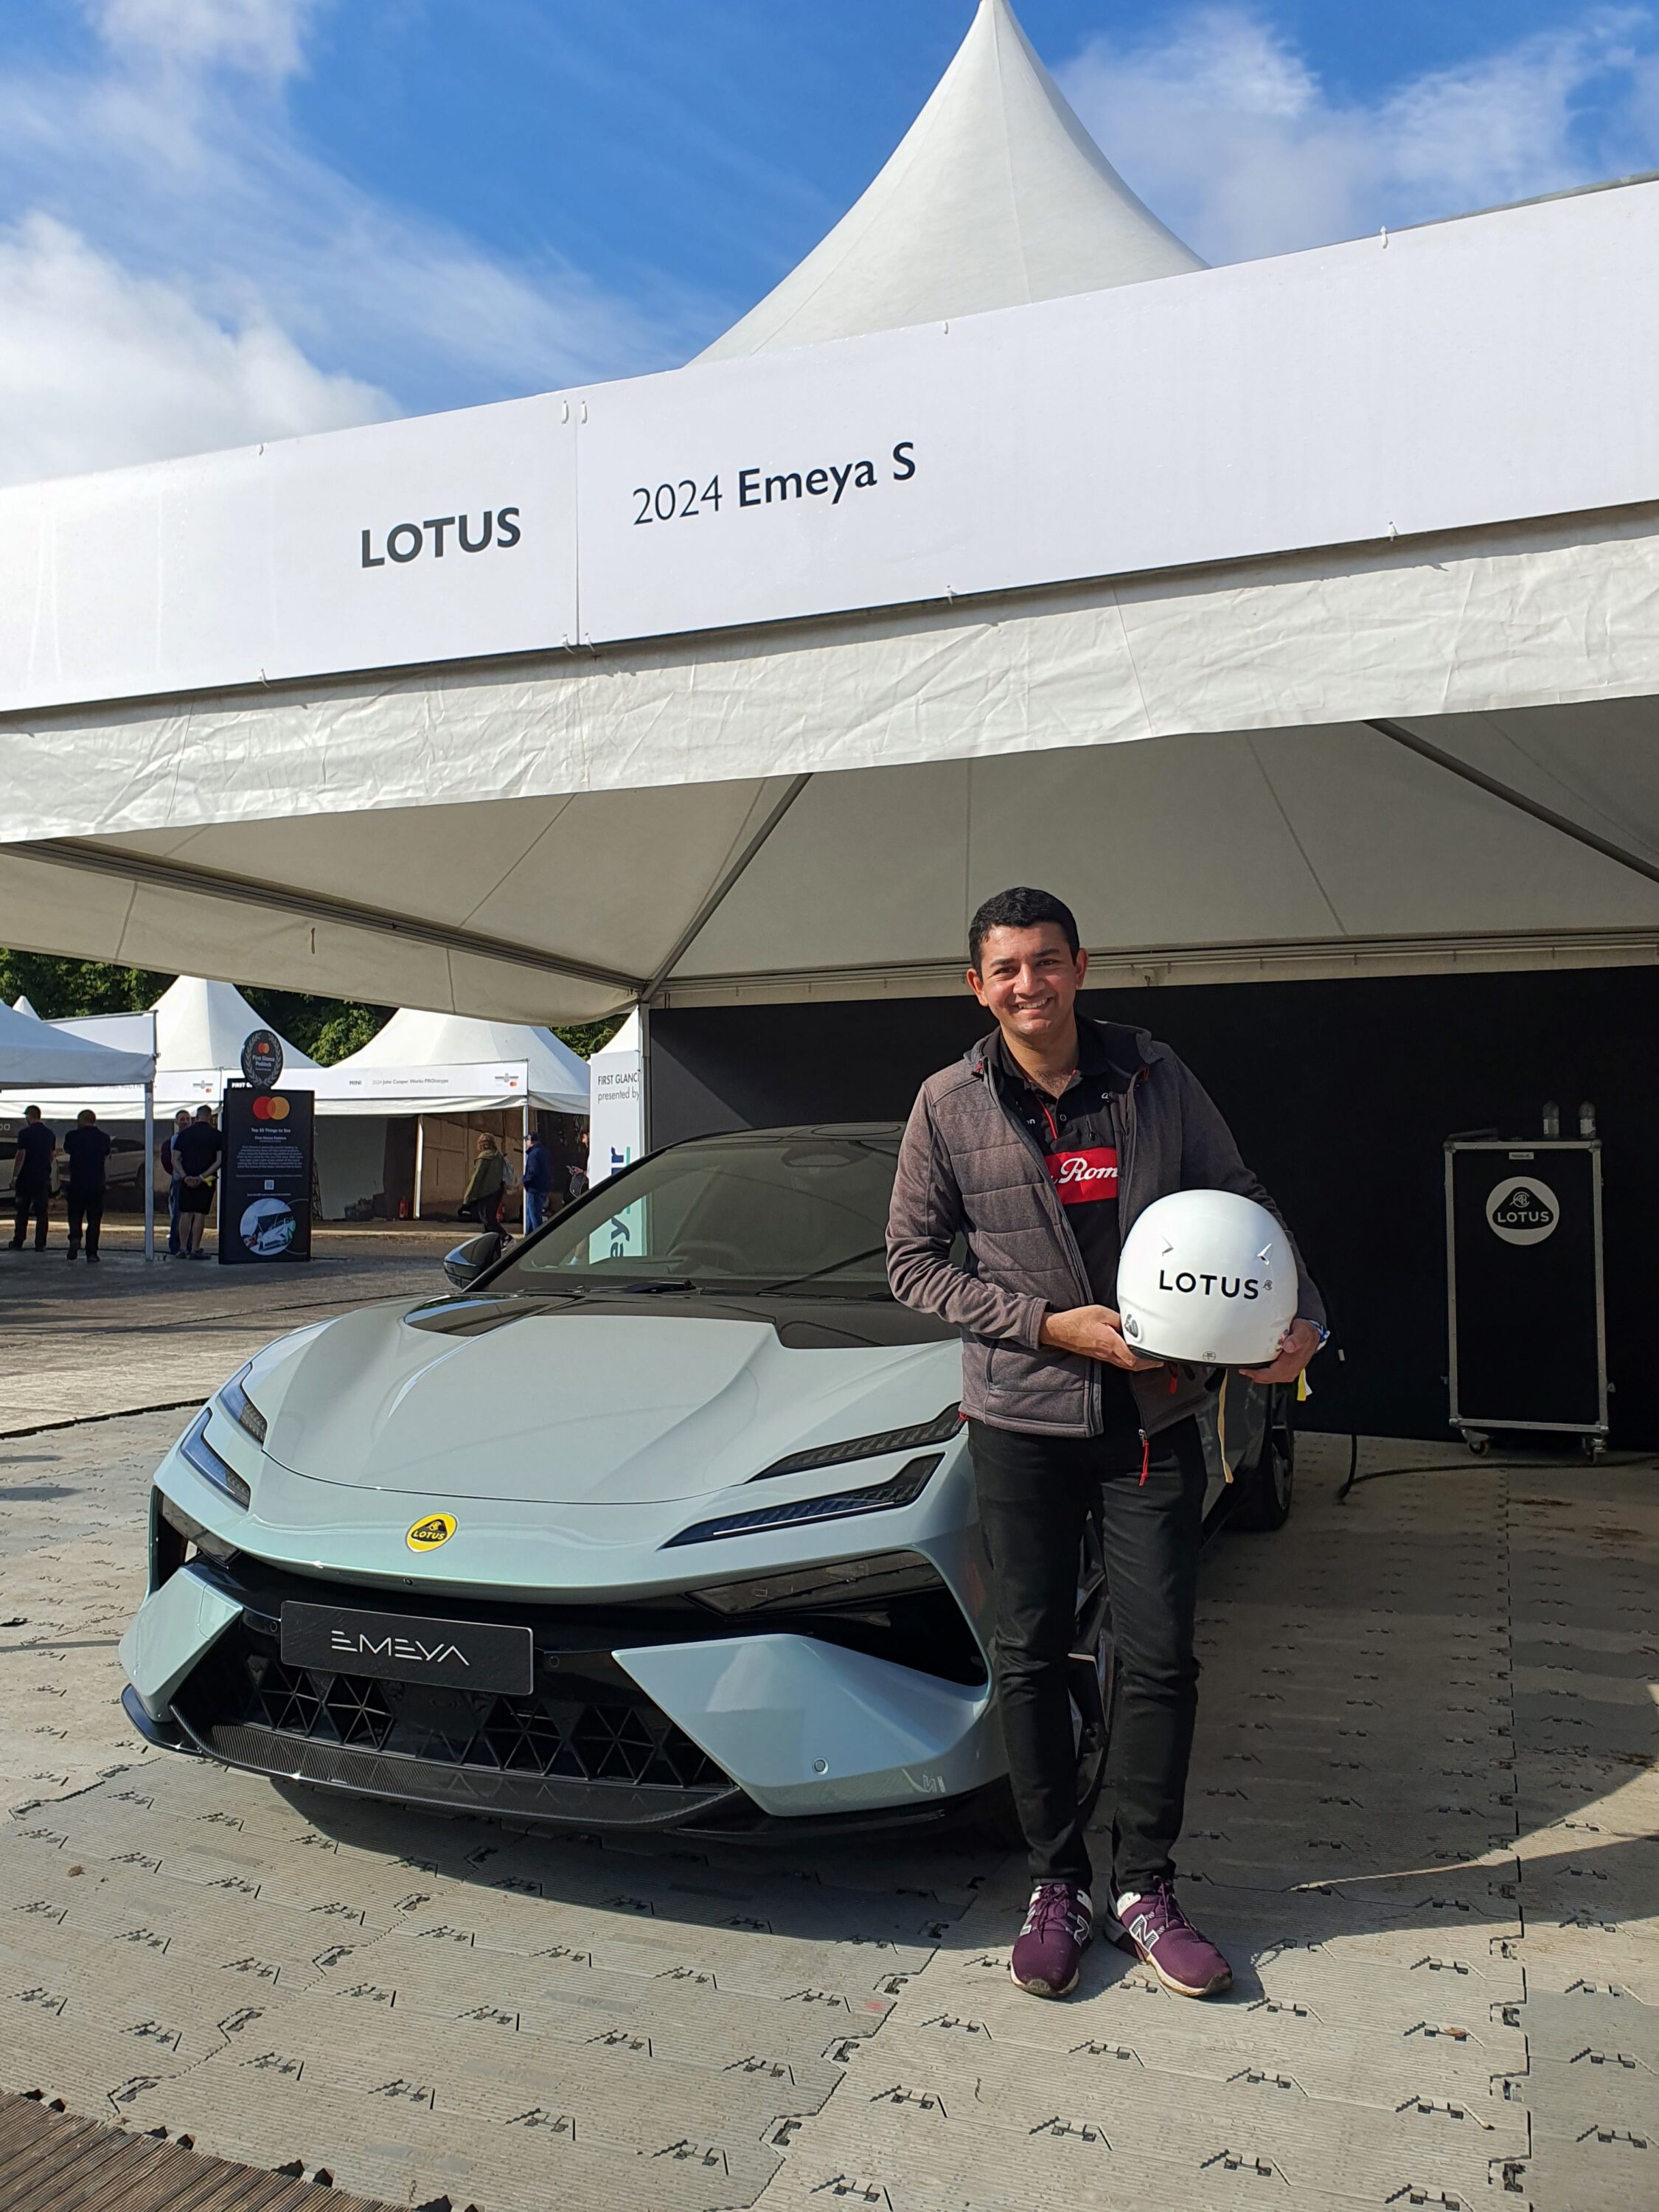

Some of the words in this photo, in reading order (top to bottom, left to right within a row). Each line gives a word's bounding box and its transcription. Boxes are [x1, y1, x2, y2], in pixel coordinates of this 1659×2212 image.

[633, 475, 722, 524] 2024
[738, 459, 877, 504] Emeya
[892, 442, 917, 481] S
[361, 507, 521, 568] LOTUS
[597, 1074, 613, 1086] FIRST
[615, 1072, 639, 1084] GLANC
[597, 1086, 630, 1105] presented
[631, 1085, 640, 1102] by
[1497, 1211, 1550, 1222] LOTUS
[1158, 1269, 1259, 1300] LOTUS
[413, 1531, 445, 1540] LOTUS
[330, 1630, 470, 1666] EMEYA
